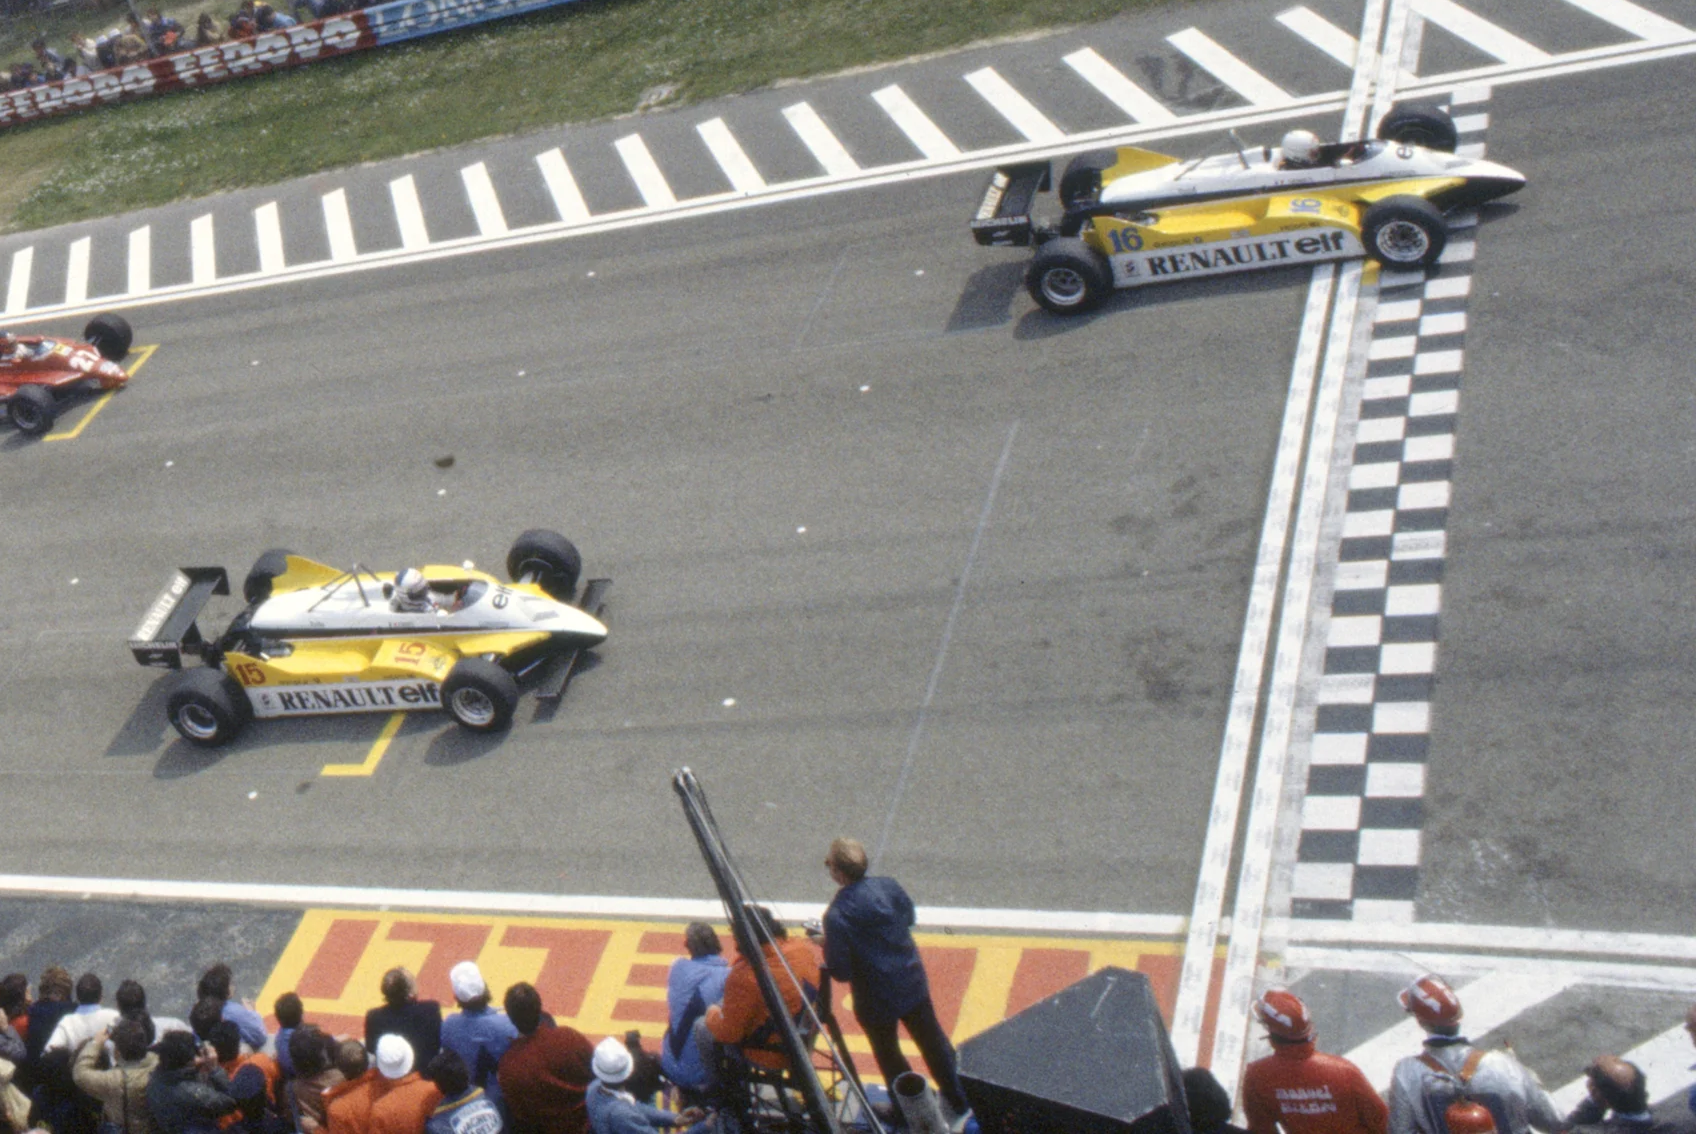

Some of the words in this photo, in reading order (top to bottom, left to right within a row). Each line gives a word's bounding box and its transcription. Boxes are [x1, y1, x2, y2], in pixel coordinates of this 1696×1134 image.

[171, 16, 362, 86] FERODO
[1289, 197, 1323, 214] 16
[1107, 226, 1144, 253] 16
[1146, 238, 1291, 276] RENAULT
[1294, 229, 1346, 255] elf
[393, 640, 427, 666] 15
[235, 662, 267, 686] 15
[277, 685, 397, 711] RENAULT
[397, 681, 440, 703] elf
